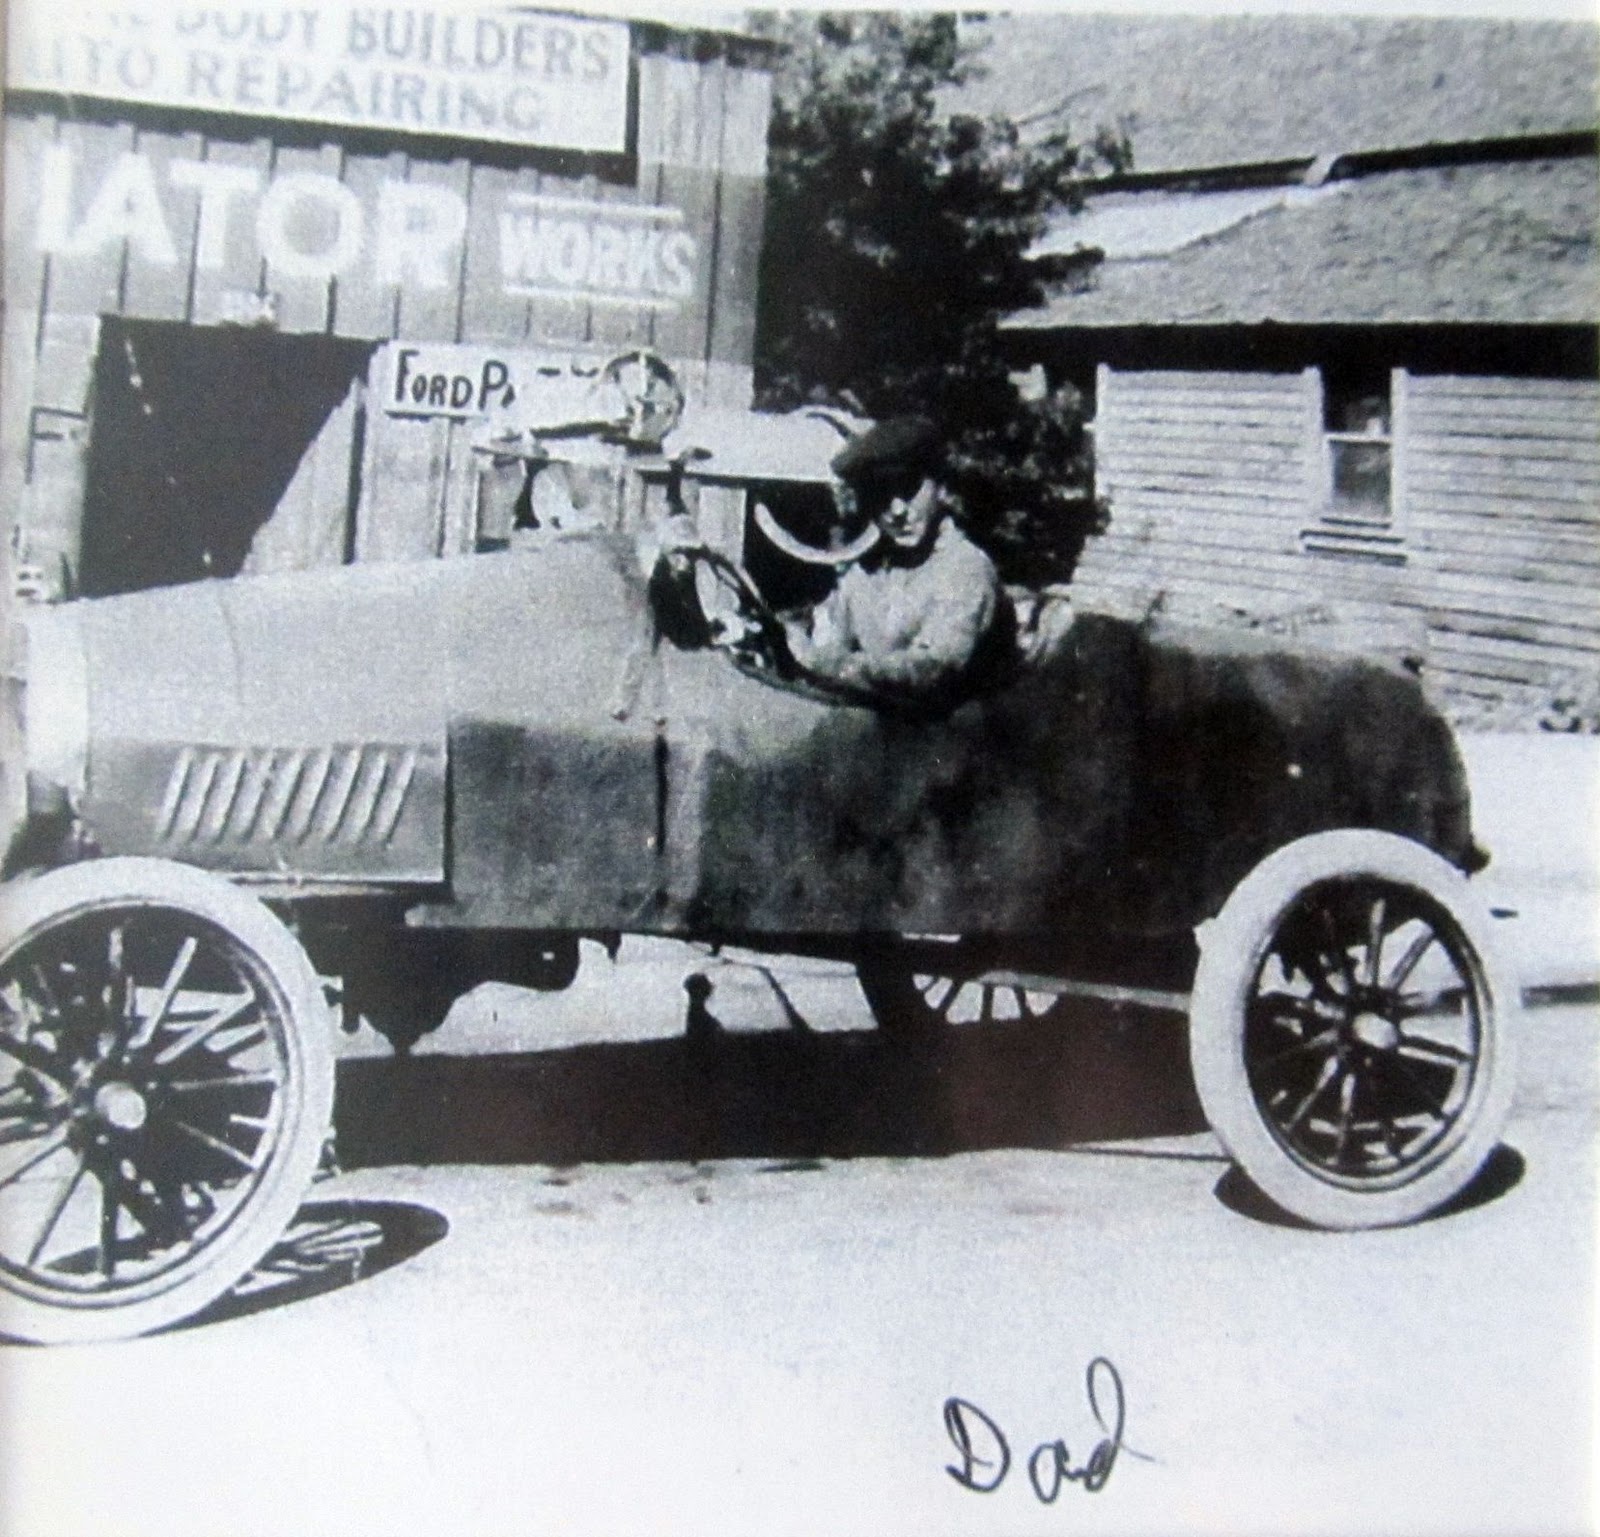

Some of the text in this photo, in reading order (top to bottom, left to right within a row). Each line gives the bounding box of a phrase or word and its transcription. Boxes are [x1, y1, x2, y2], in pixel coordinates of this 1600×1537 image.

[348, 9, 612, 83] BUILDERS
[184, 48, 544, 132] REPAIRING
[35, 142, 697, 297] IATOR WORKS
[394, 349, 474, 409] FORD
[943, 1355, 1158, 1505] Dad
